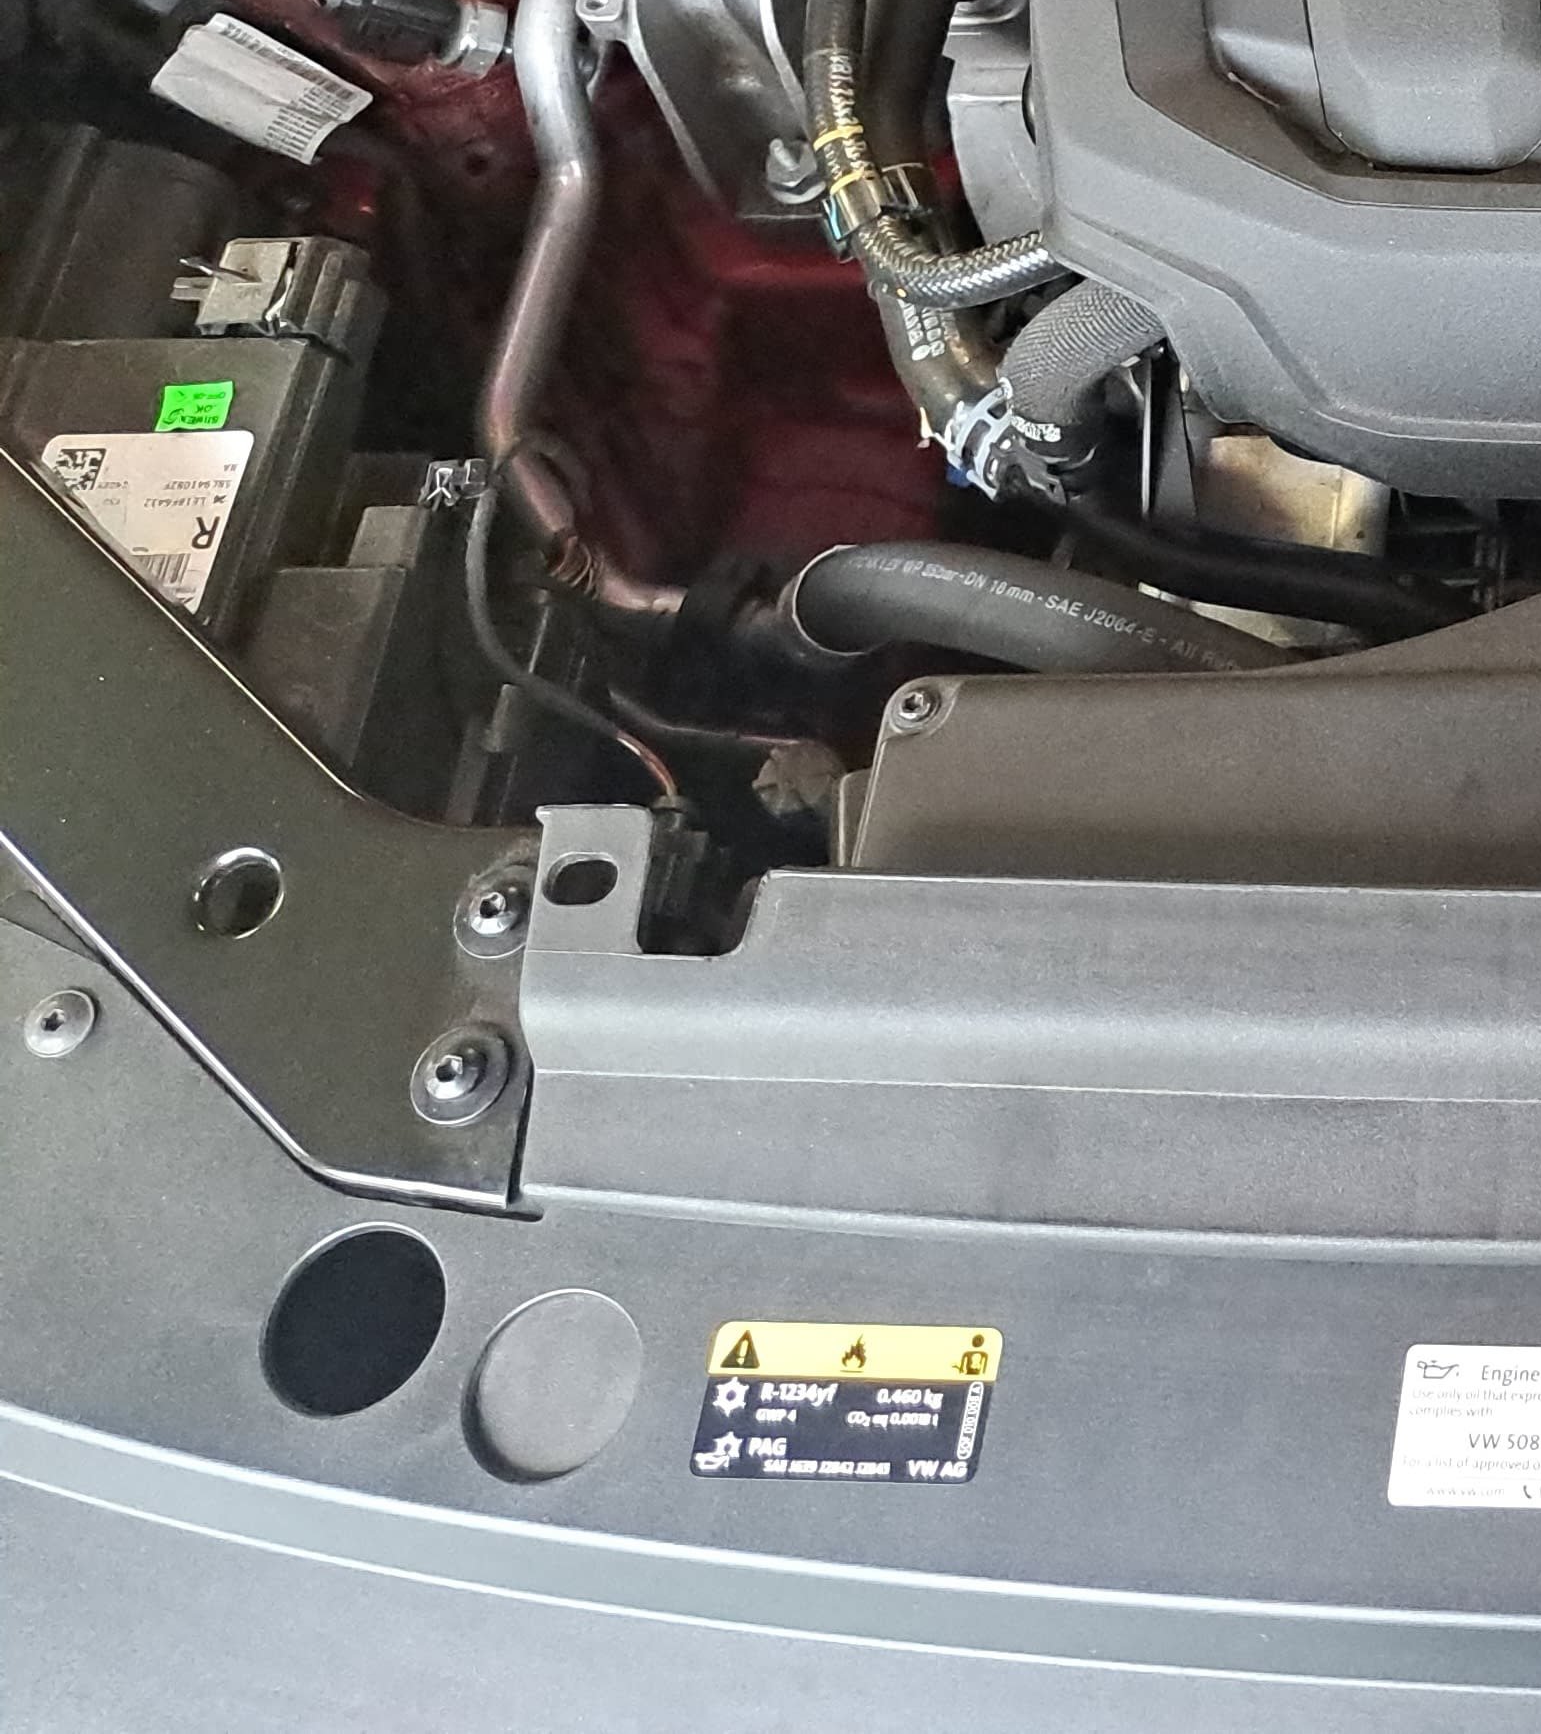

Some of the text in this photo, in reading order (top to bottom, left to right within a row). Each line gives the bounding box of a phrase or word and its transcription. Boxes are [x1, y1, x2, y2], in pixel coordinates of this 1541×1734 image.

[191, 516, 220, 550] R
[1045, 594, 1082, 618] SAE
[1481, 1365, 1540, 1386] Engine
[760, 1383, 837, 1407] R-1234yf
[924, 1391, 943, 1409] kg
[1483, 1389, 1507, 1401] that
[1466, 1407, 1493, 1417] with
[748, 1437, 787, 1456] PAG
[1468, 1433, 1500, 1450] VW
[1507, 1434, 1540, 1450] 508
[907, 1459, 968, 1478] VW AG
[1474, 1459, 1531, 1472] approved
